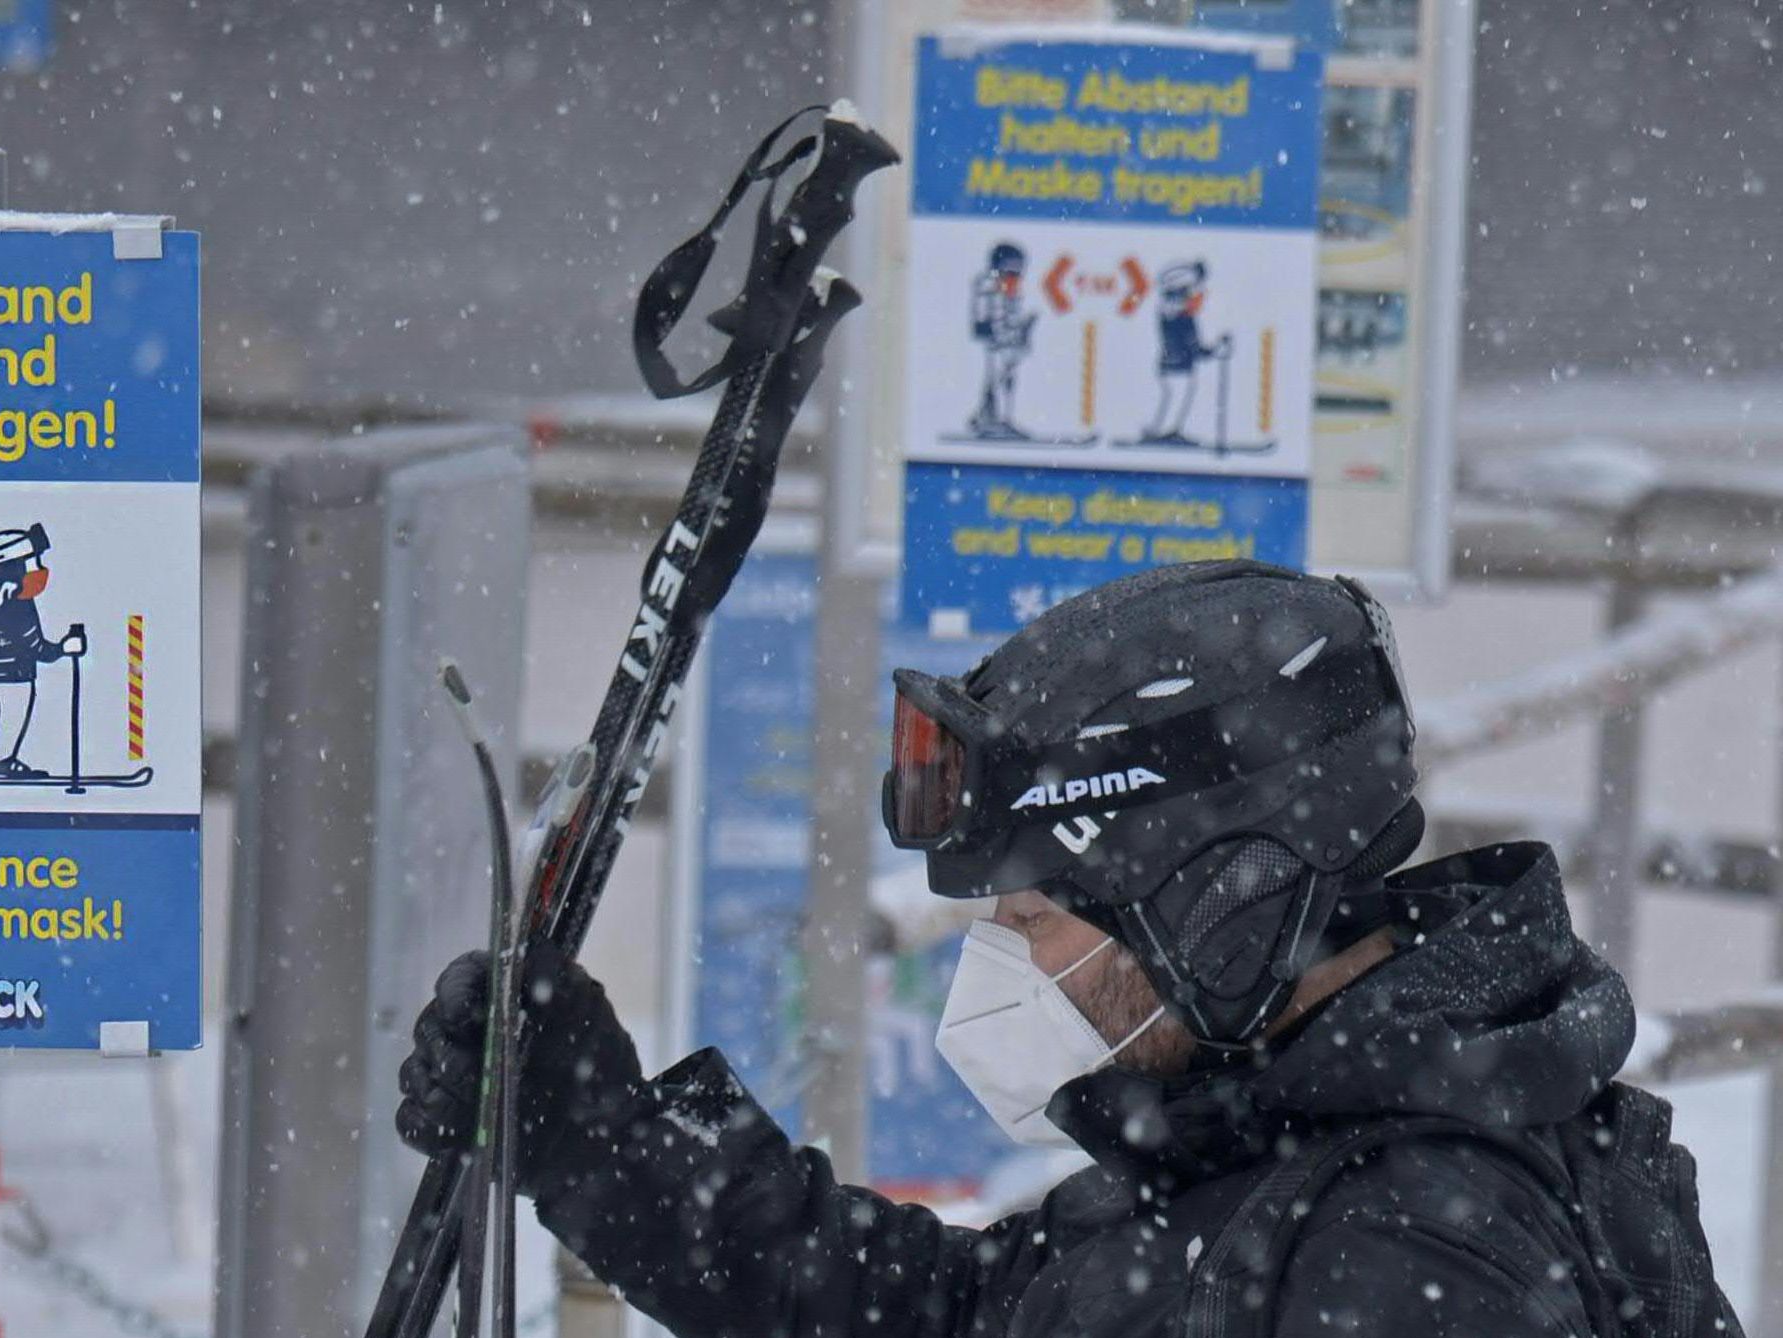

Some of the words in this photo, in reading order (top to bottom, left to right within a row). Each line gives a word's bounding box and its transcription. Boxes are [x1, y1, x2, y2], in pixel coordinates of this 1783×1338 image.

[976, 66, 1066, 110] Bitte
[1077, 71, 1249, 115] Abstand
[1001, 114, 1130, 156] halten
[1140, 122, 1220, 160] und
[966, 160, 1103, 201] Maske
[1113, 167, 1262, 214] tragen!
[621, 520, 699, 682] LEKI
[1010, 766, 1167, 811] ALPINA
